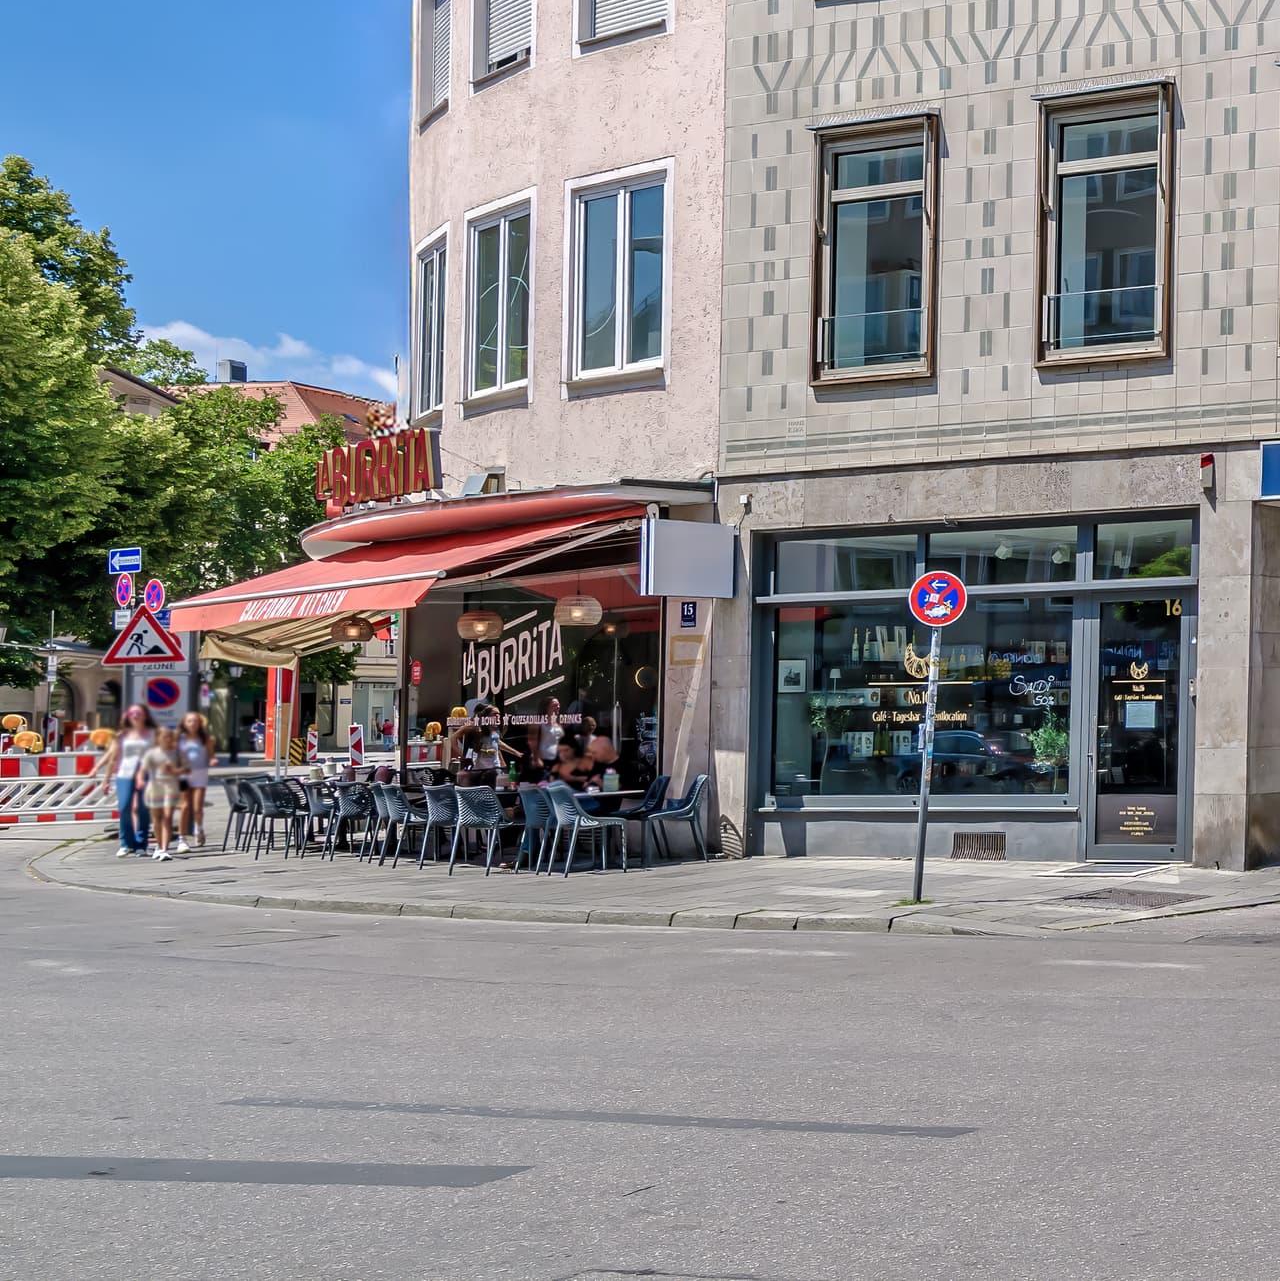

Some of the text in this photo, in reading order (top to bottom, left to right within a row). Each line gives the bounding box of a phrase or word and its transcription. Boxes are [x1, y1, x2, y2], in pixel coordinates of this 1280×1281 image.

[683, 603, 694, 616] 15
[1164, 598, 1183, 616] 16
[462, 640, 476, 686] LA
[934, 710, 968, 722] entlocation
